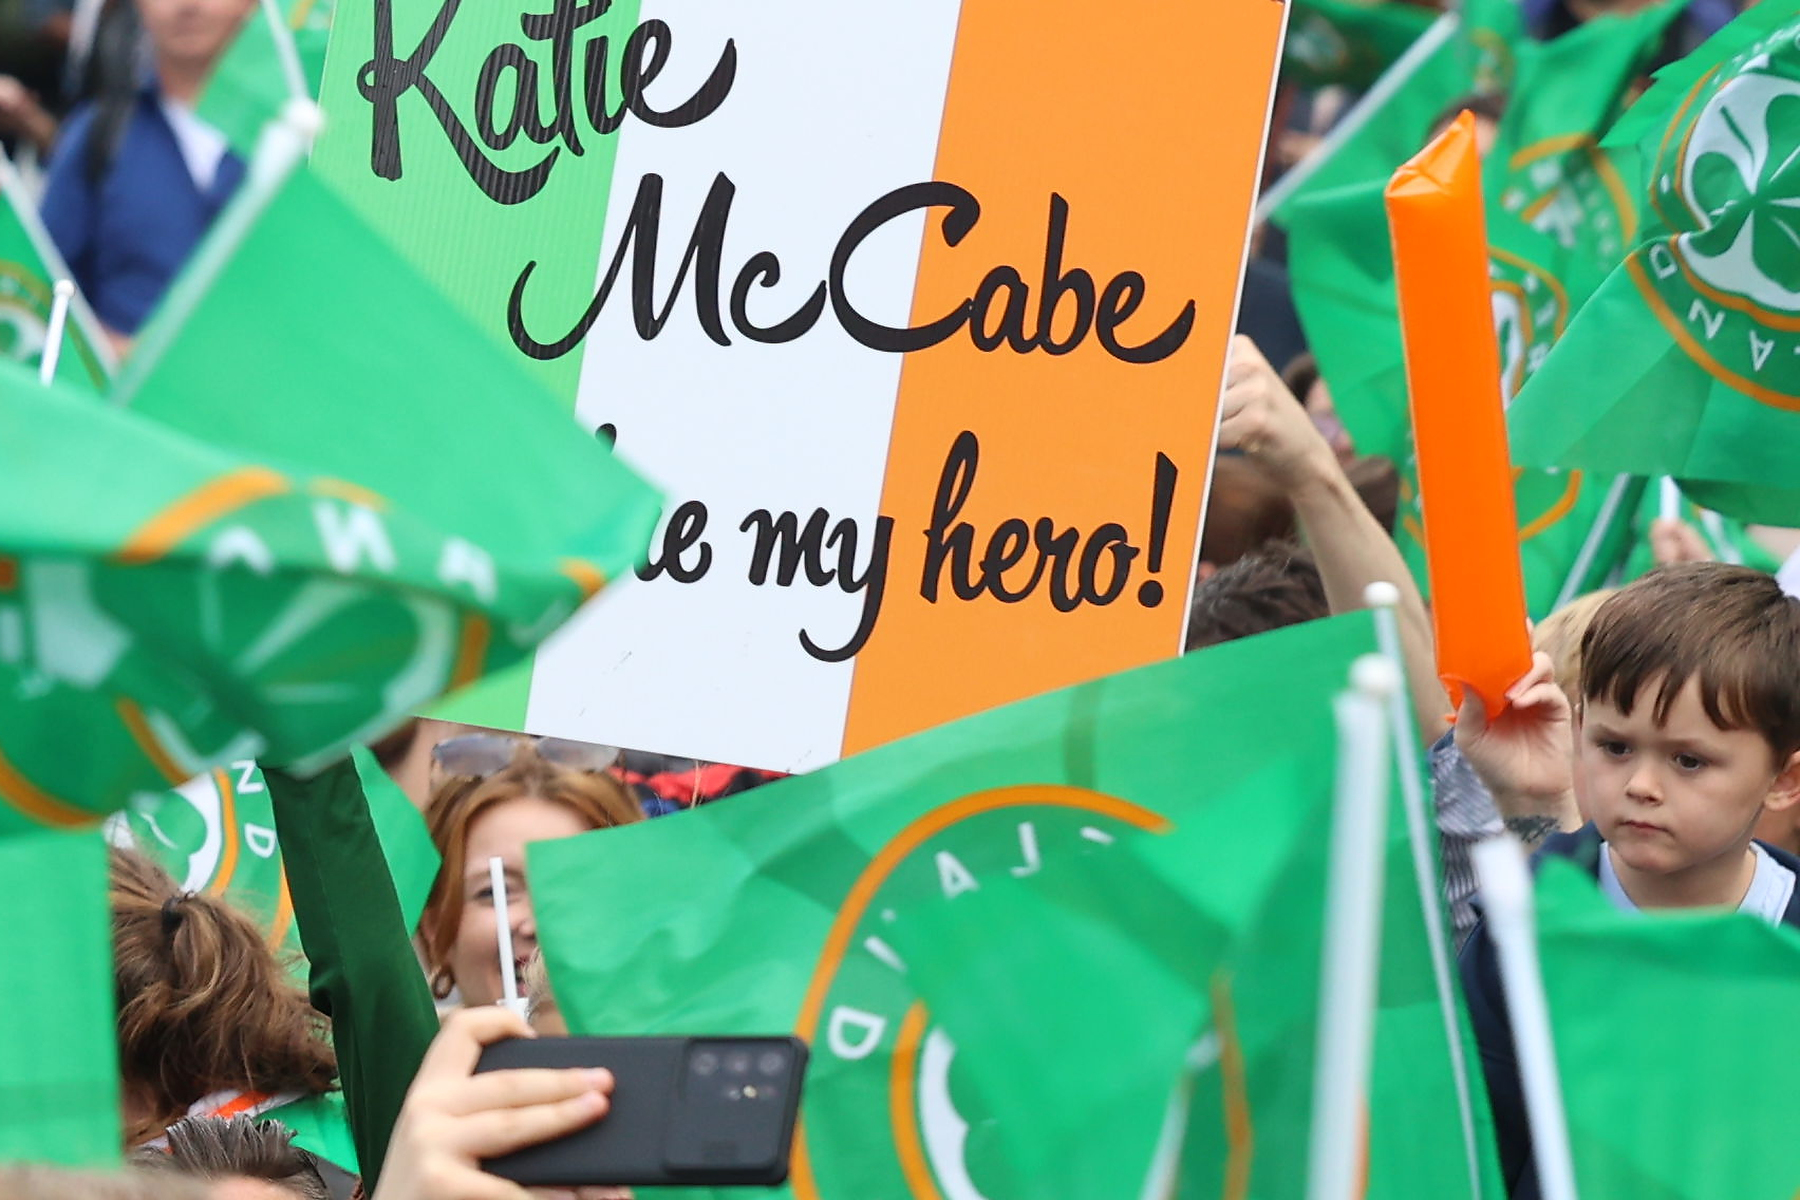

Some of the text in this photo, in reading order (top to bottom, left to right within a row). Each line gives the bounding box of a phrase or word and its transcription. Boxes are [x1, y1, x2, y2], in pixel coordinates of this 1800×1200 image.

[507, 172, 1196, 365] McCabe
[738, 506, 896, 663] my
[919, 429, 1179, 614] hero!
